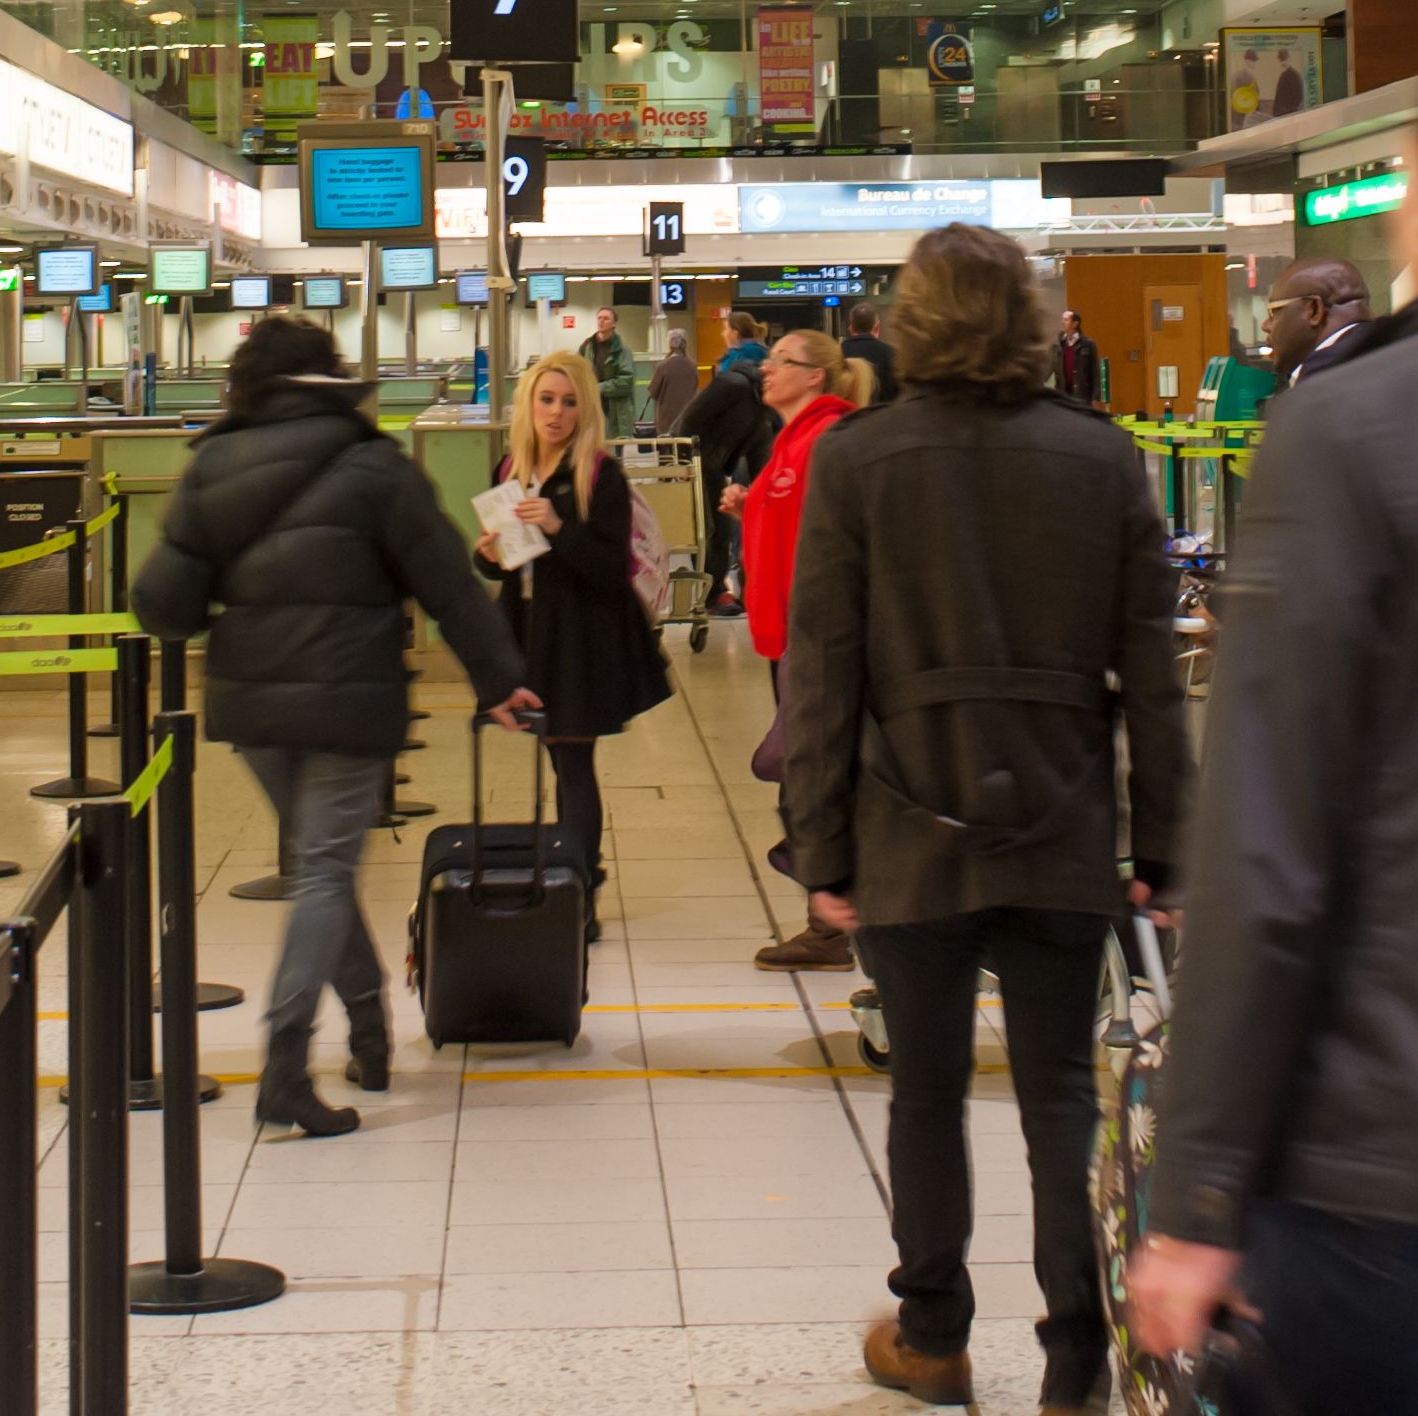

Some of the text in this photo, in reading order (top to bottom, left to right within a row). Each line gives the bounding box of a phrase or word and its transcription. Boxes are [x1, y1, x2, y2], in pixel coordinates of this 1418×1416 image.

[266, 43, 317, 73] EAT
[944, 47, 967, 62] 24
[541, 109, 630, 129] Internet
[642, 106, 708, 126] Access
[503, 156, 529, 195] 9
[858, 187, 987, 204] Bureau de Change
[821, 204, 987, 218] International Currency Exchange
[653, 214, 679, 240] 11
[820, 267, 836, 279] 14
[660, 283, 684, 304] 13
